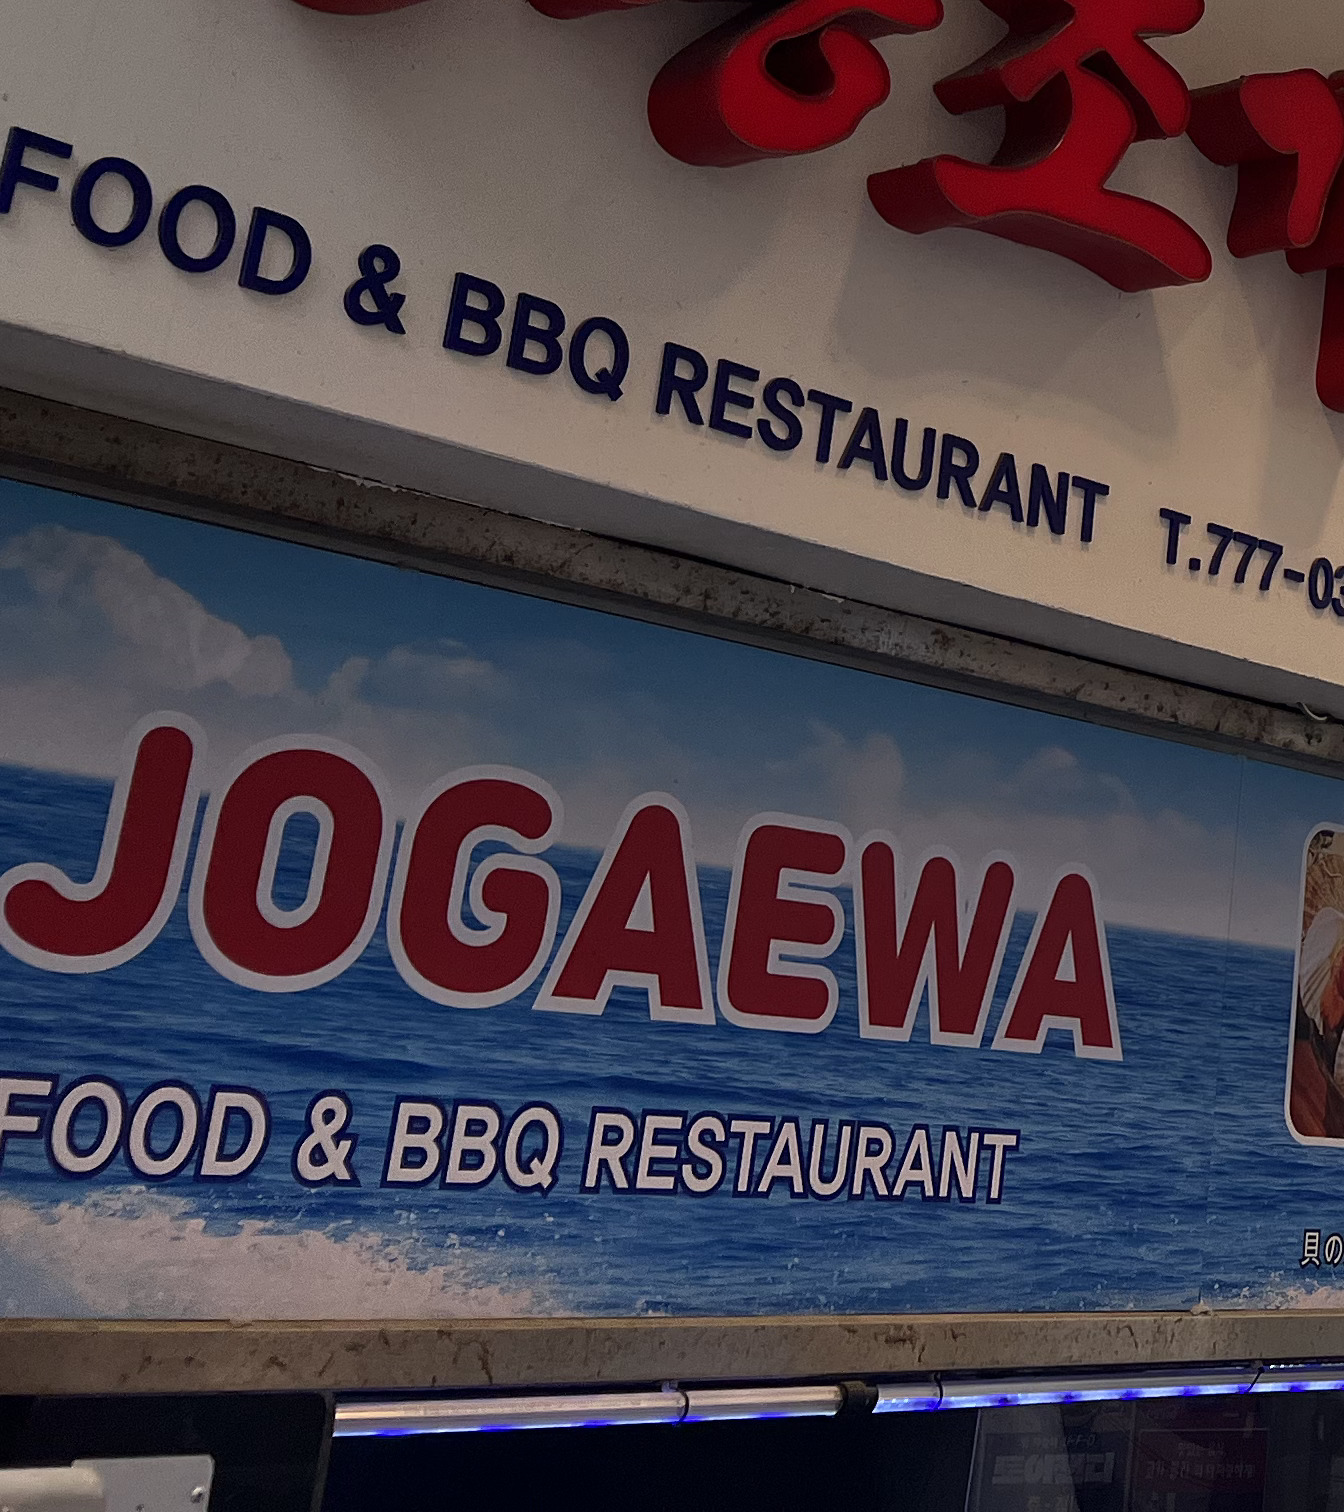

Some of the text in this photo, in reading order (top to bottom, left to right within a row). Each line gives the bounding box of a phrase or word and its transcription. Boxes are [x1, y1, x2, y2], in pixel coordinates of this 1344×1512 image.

[343, 244, 407, 335] &
[442, 272, 630, 402] BBQ
[654, 340, 1110, 547] RESTAURANT
[0, 712, 1122, 1060] JOGAEWA
[294, 1091, 355, 1186] &
[386, 1096, 562, 1192] BBQ
[584, 1108, 1020, 1206] RESTAURANT
